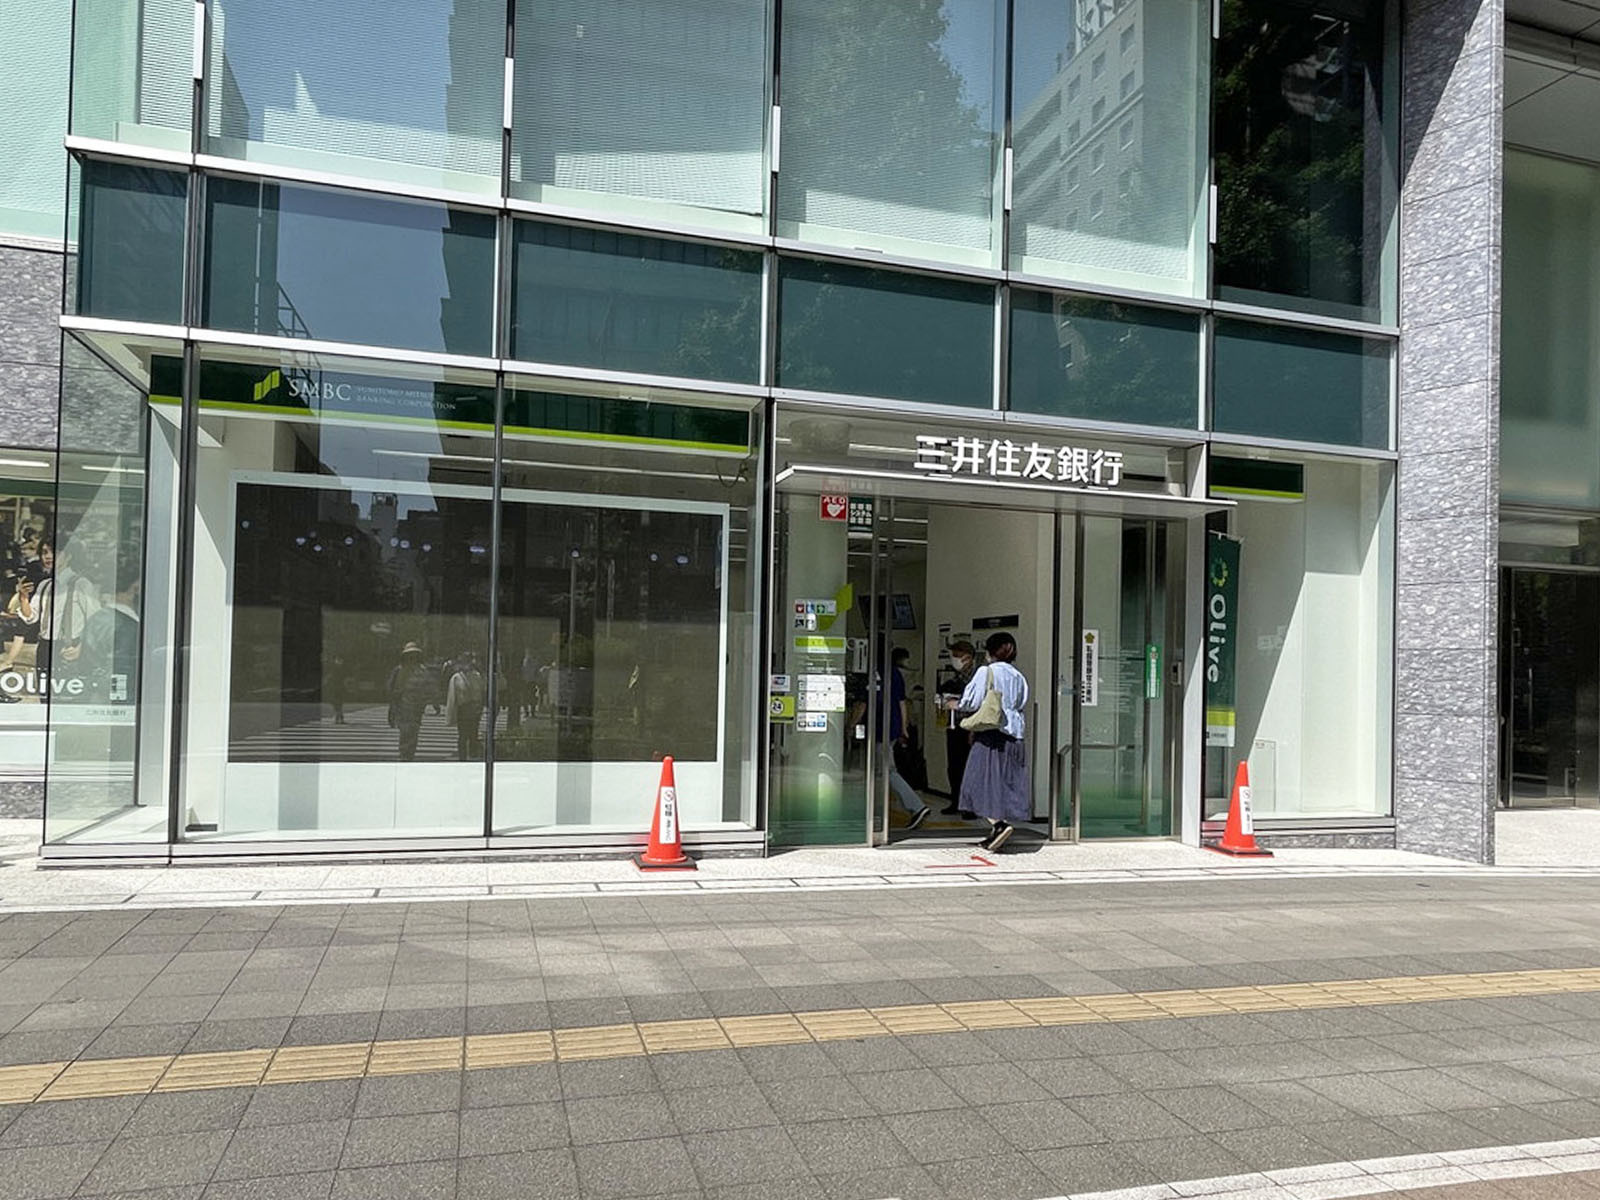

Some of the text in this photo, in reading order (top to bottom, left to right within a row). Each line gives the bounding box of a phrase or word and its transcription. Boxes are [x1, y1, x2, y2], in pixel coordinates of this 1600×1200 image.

[289, 378, 352, 401] SMBC
[914, 435, 1124, 486] 三井住友銀行
[1207, 594, 1227, 683] Olive
[0, 672, 84, 694] Olive
